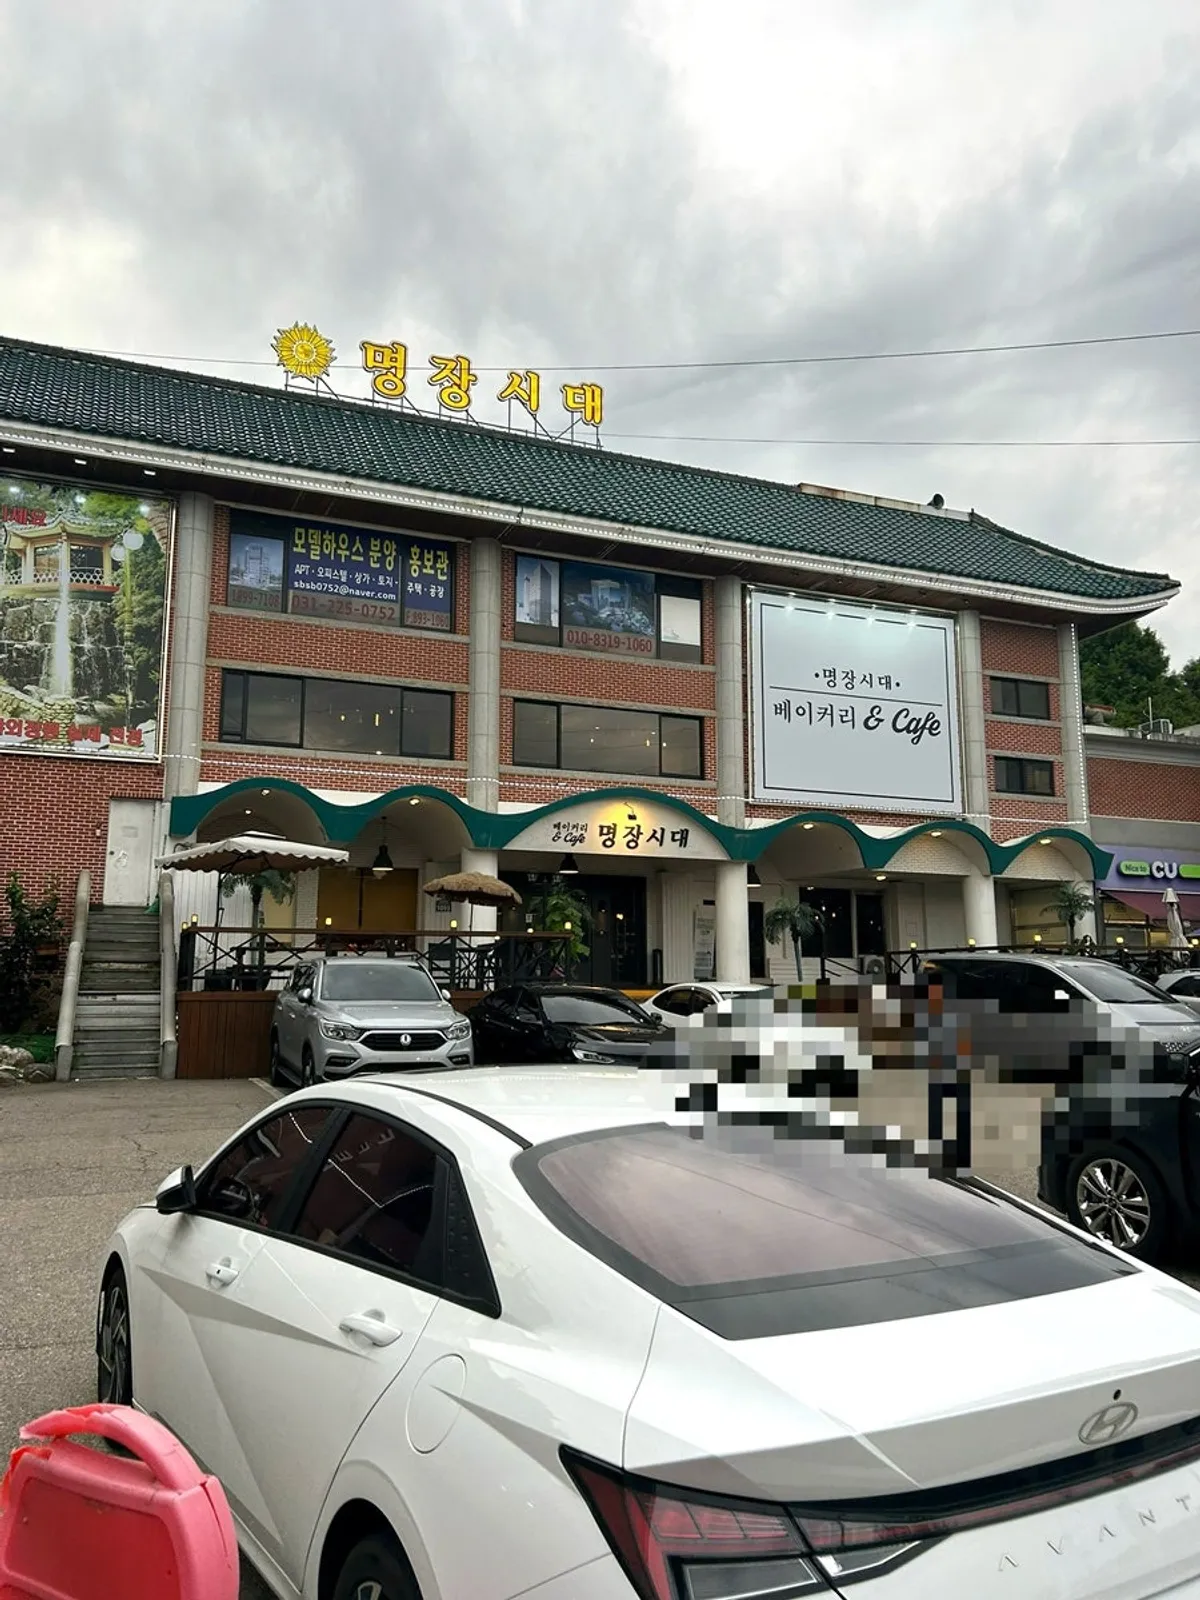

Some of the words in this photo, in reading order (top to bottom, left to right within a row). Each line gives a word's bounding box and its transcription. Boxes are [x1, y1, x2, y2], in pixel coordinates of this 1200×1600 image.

[360, 340, 602, 427] 명장시대
[293, 527, 364, 563] 모델하우스
[369, 537, 397, 572] 분양
[409, 545, 449, 581] 홍보관
[294, 564, 310, 575] APT
[354, 572, 370, 584] 상가
[377, 575, 393, 587] 토지
[293, 580, 396, 600] sbsb0752@naver.com
[292, 595, 396, 620] 031-225-0752
[567, 629, 653, 652] 010-8319-1060
[822, 667, 892, 690] 명장시대
[773, 699, 855, 729] 베이커리
[863, 705, 885, 730] &
[891, 707, 941, 745] Cafe
[552, 821, 588, 833] 베이커리
[598, 823, 690, 849] 명장시대
[551, 832, 562, 842] &
[564, 832, 587, 847] Cafe
[1151, 861, 1178, 878] CU
